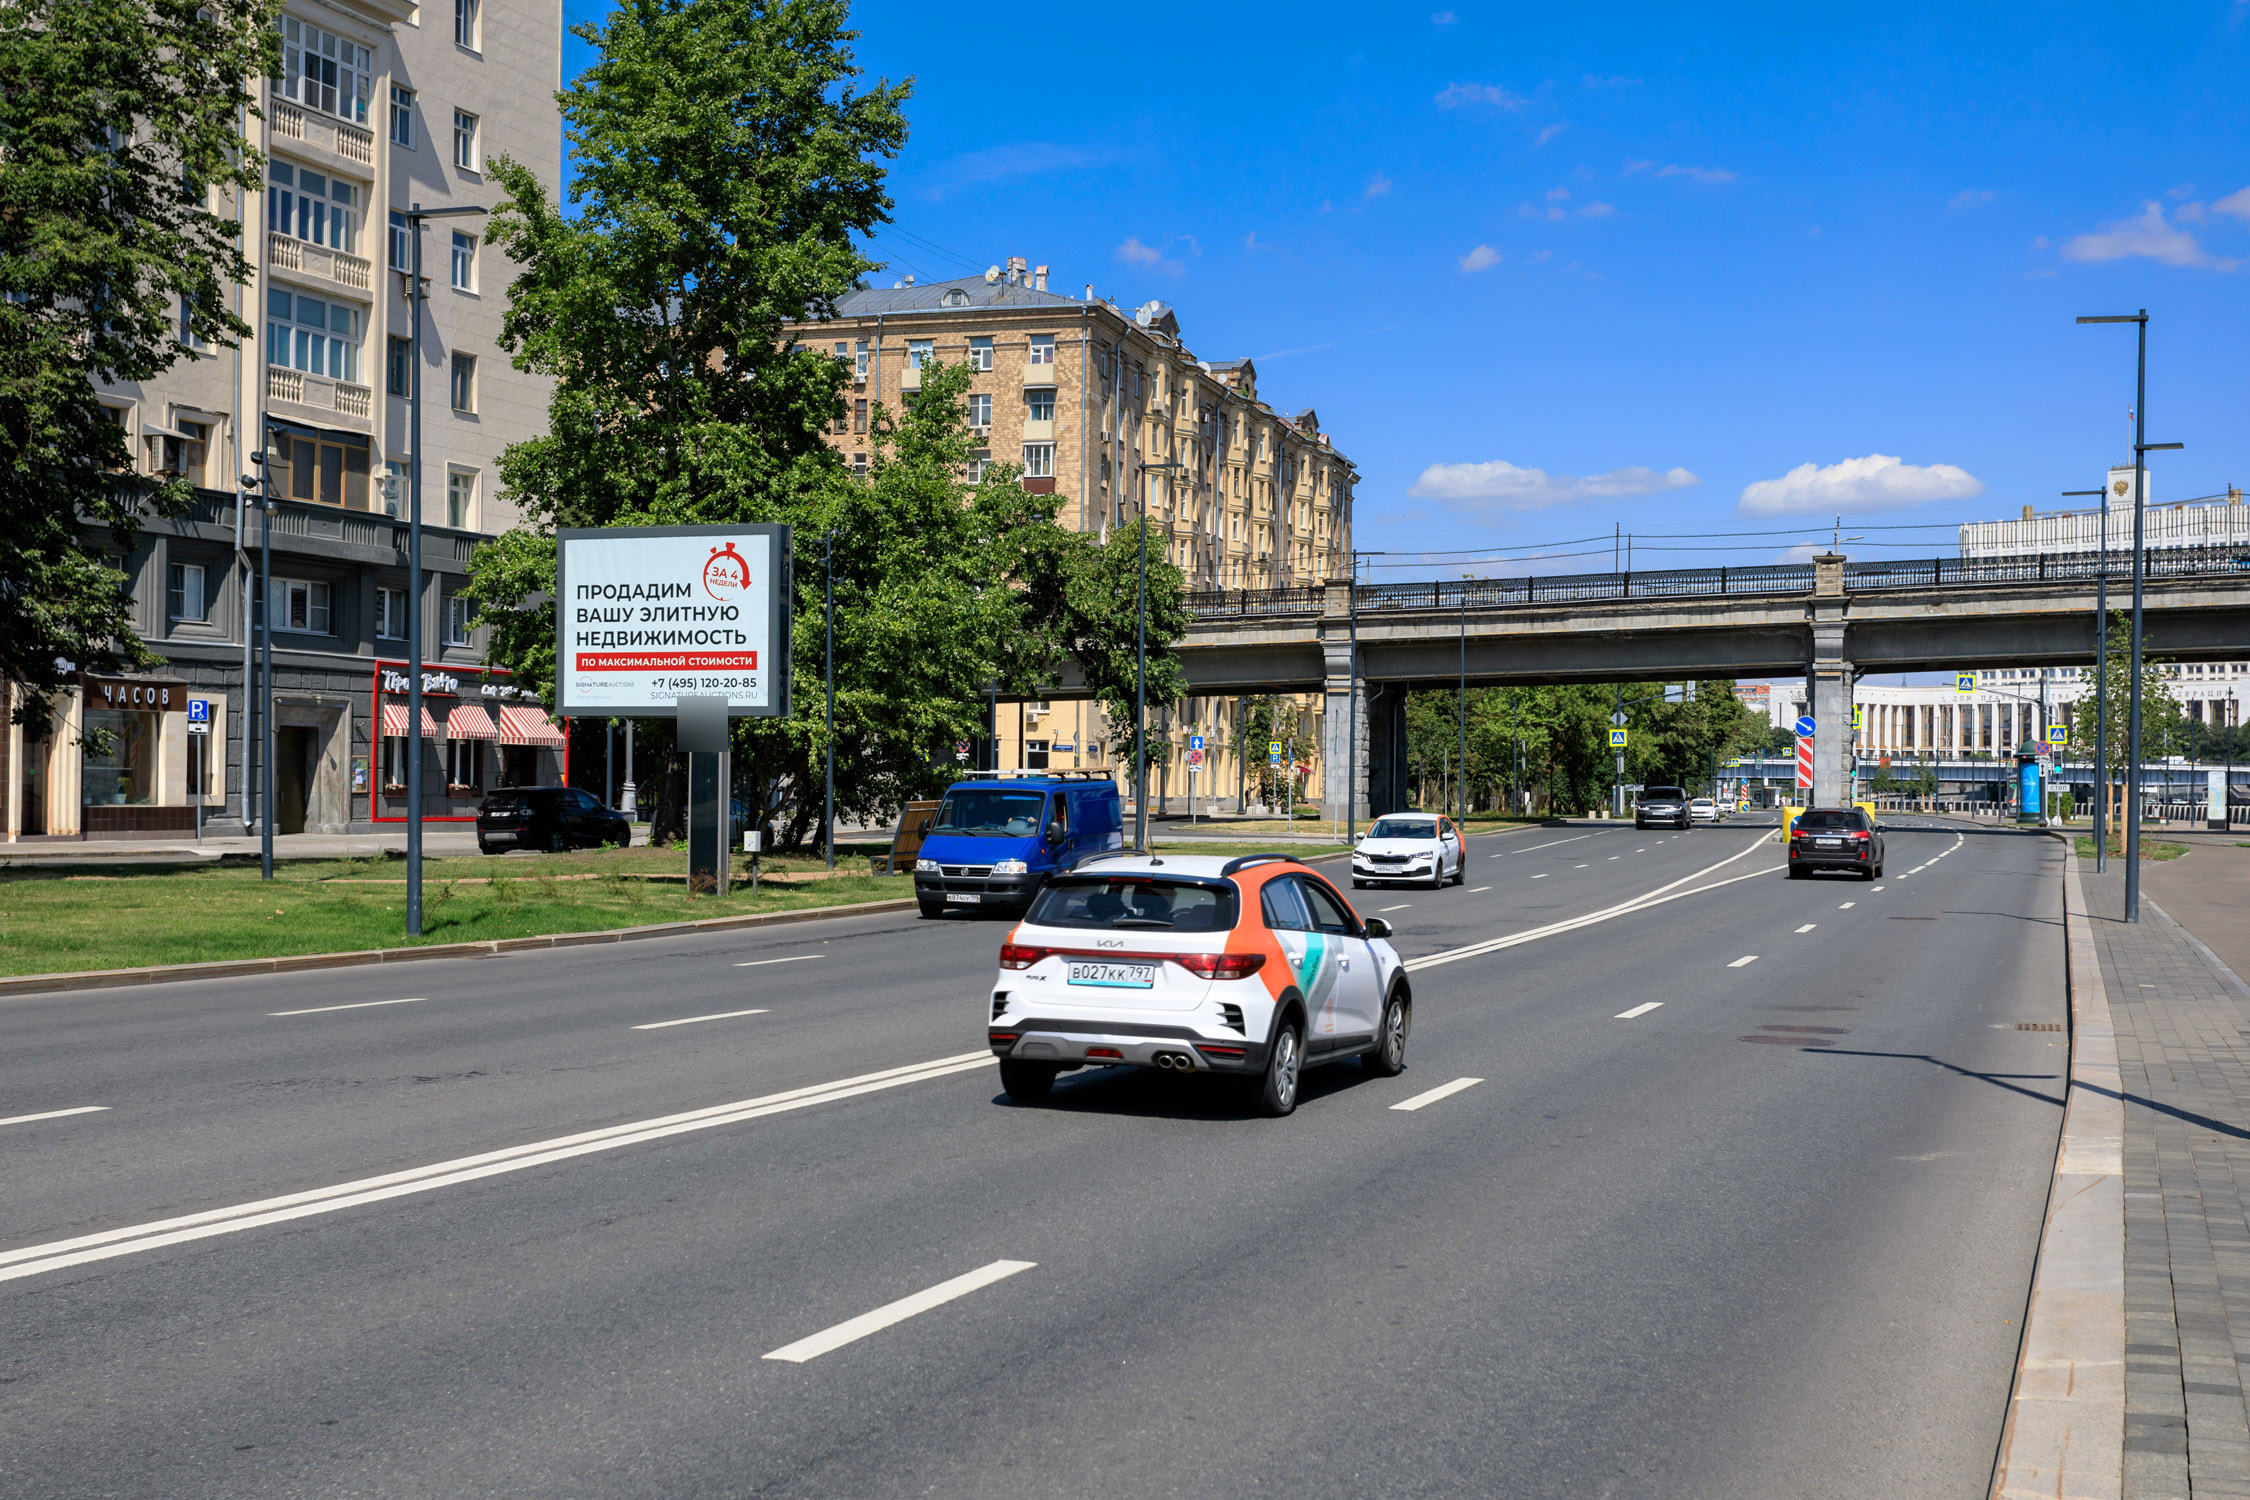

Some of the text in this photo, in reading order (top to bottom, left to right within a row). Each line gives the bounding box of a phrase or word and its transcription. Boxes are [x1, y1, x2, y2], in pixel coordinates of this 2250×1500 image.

[711, 566, 738, 580] ЗА 4
[709, 577, 738, 588] НЕДЕЛИ
[576, 583, 692, 602] ПРОДАДИМ
[576, 605, 740, 623] ВАШУ ЭЛИТНУЮ
[576, 629, 747, 649] НЕДВИЖИМОСТЬ
[581, 655, 753, 667] ПО МАКСИМАЛЬНОЙ СТОИМОСТИ
[651, 677, 757, 690] +7 (495) 120-20-85
[103, 685, 169, 705] ЧАСОВ
[1129, 966, 1151, 978] 797
